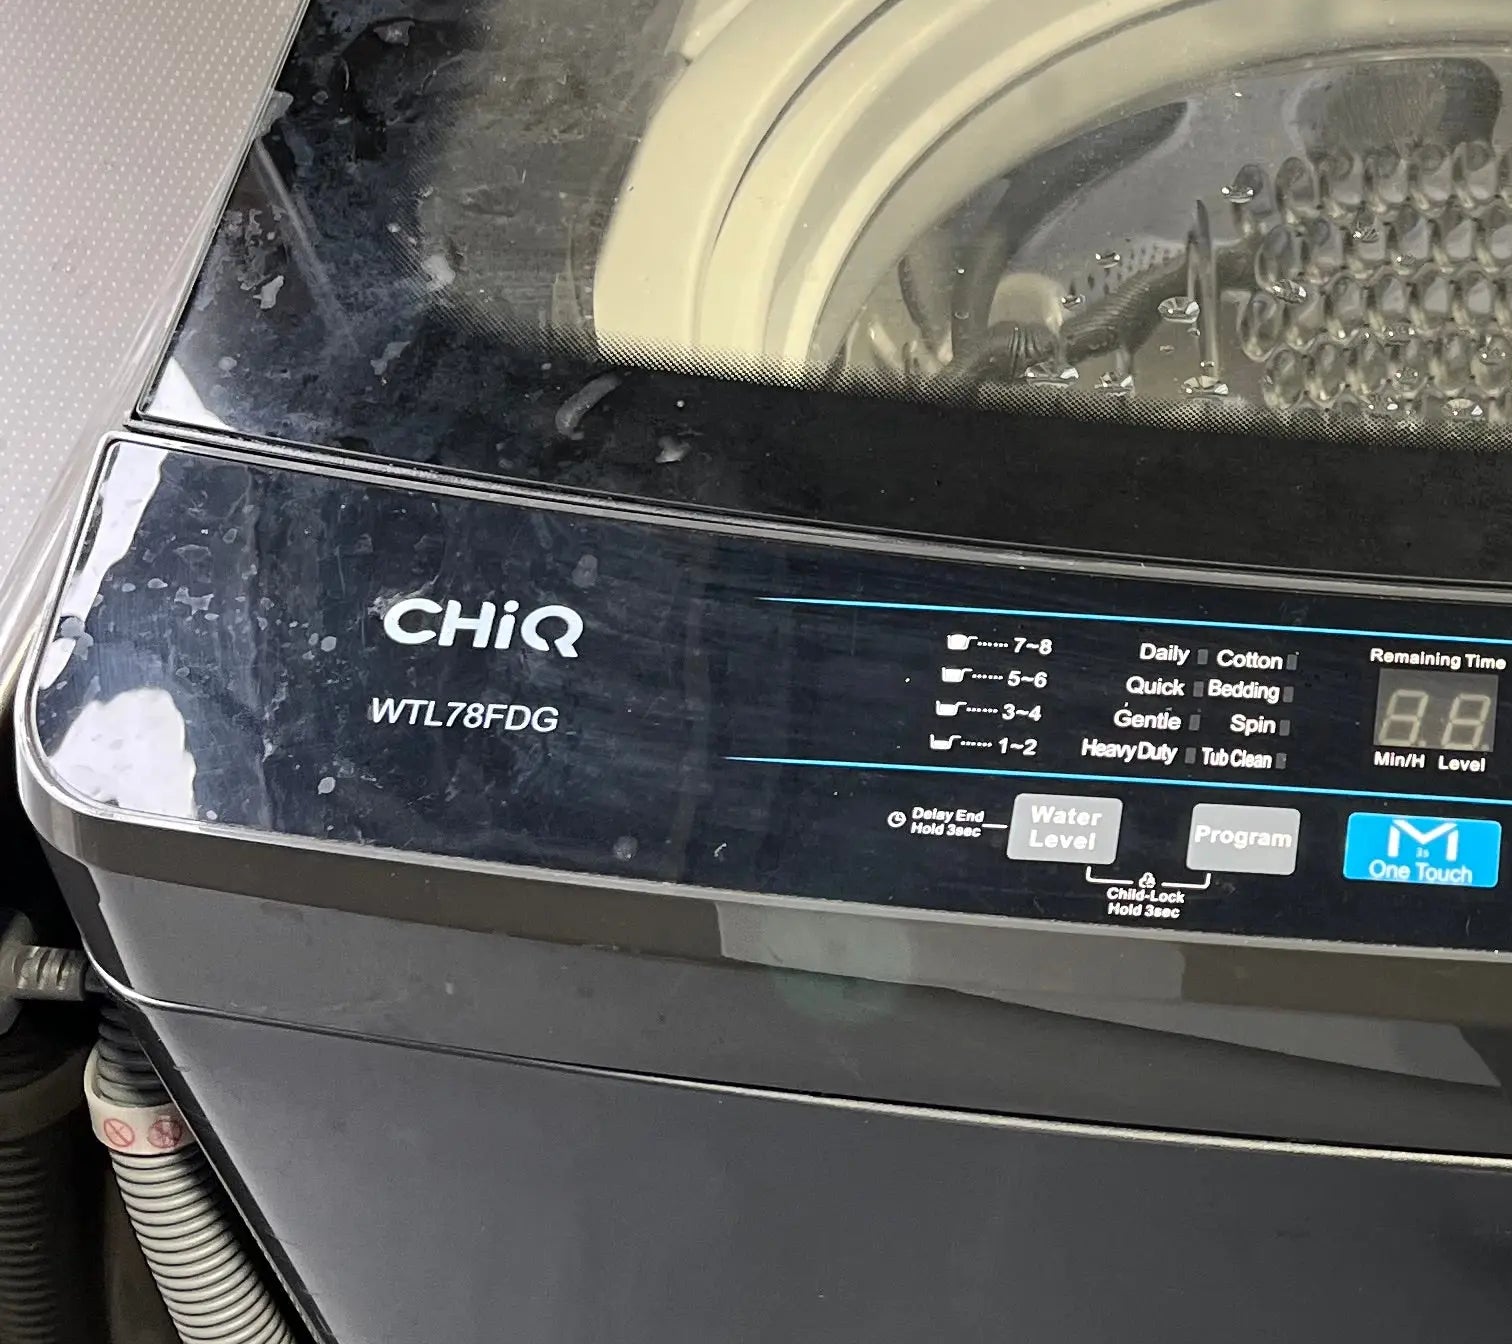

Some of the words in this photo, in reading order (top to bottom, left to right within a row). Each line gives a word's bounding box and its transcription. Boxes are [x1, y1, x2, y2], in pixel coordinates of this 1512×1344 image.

[1139, 642, 1191, 667] Daily
[1216, 649, 1284, 670] Cotton
[1370, 648, 1462, 670] Remaining
[1464, 653, 1507, 670] Time
[1125, 676, 1185, 698] Quick
[1208, 680, 1280, 705] Bedding
[370, 696, 559, 733] WTL78FDG
[1113, 708, 1182, 731] Gentle
[1230, 714, 1276, 737] Spin
[1374, 751, 1425, 770] Min/H
[1438, 754, 1486, 774] Level
[912, 806, 953, 824] Delay
[956, 809, 985, 824] End
[1030, 805, 1103, 826] Water
[910, 822, 943, 837] Hold
[947, 825, 981, 838] 3sec
[1028, 830, 1097, 852] Level
[1194, 825, 1293, 852] Program
[1368, 859, 1411, 880] One
[1415, 861, 1473, 885] Touch
[1106, 886, 1185, 905] Child-Lock
[1108, 902, 1141, 918] Hold
[1144, 904, 1181, 919] 3sec
